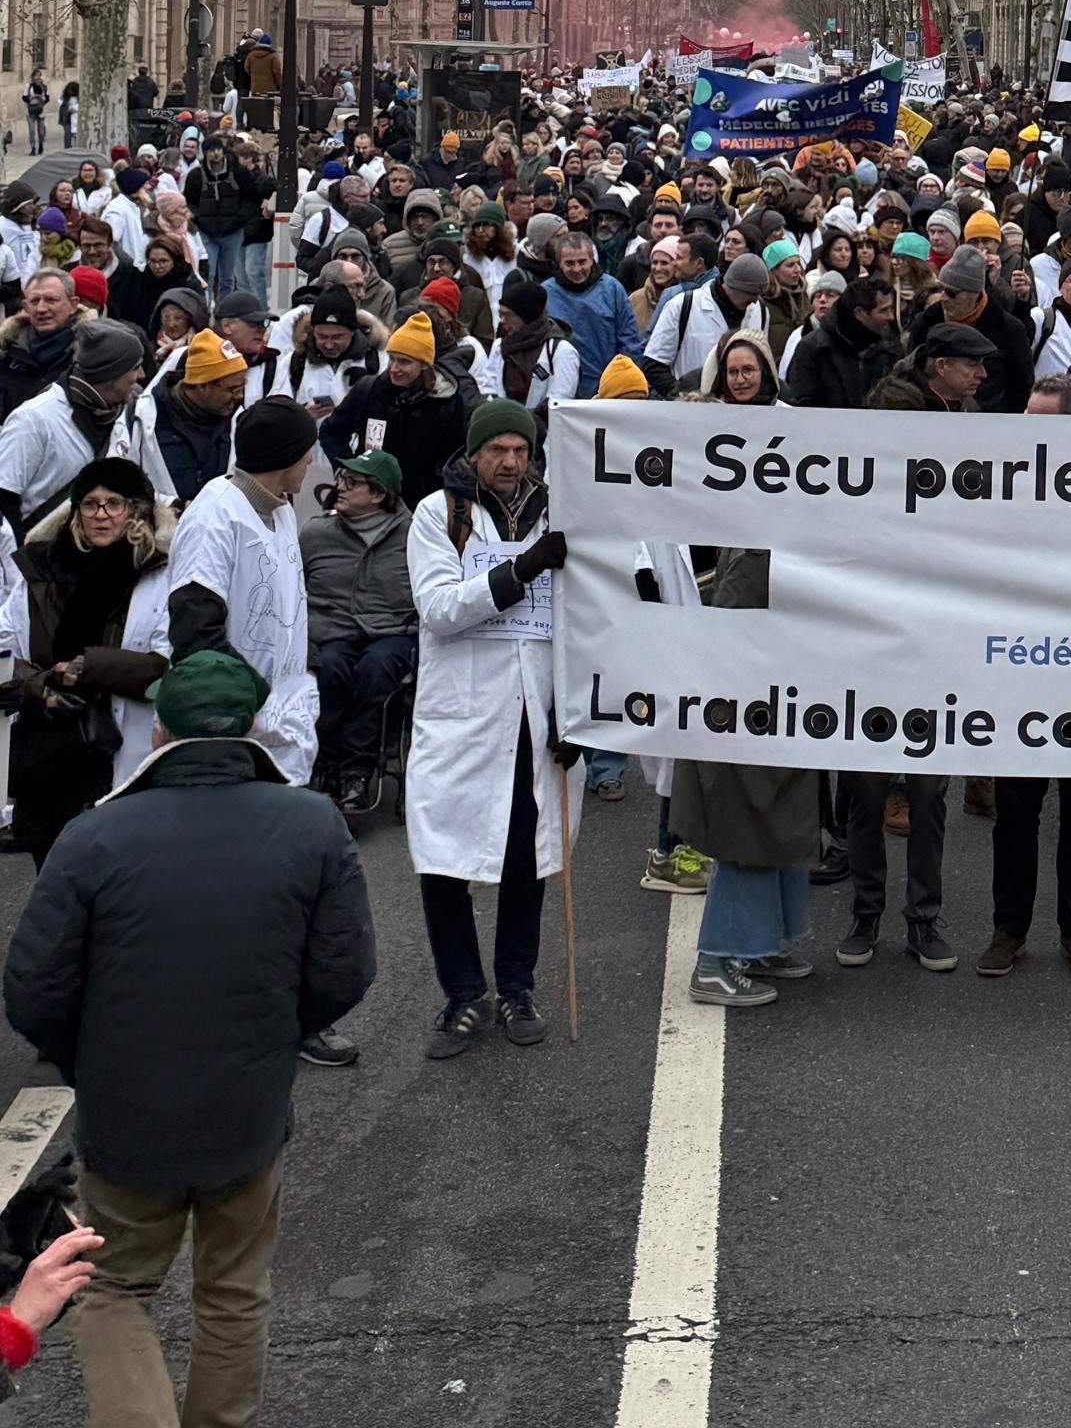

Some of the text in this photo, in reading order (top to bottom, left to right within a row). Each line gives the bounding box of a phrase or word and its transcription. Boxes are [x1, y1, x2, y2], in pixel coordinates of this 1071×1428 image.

[755, 99, 800, 112] AVEC
[719, 137, 794, 150] PATIENTS
[594, 428, 673, 487] La
[703, 433, 875, 497] Sécu
[590, 673, 656, 727] La
[678, 685, 996, 758] radiologie
